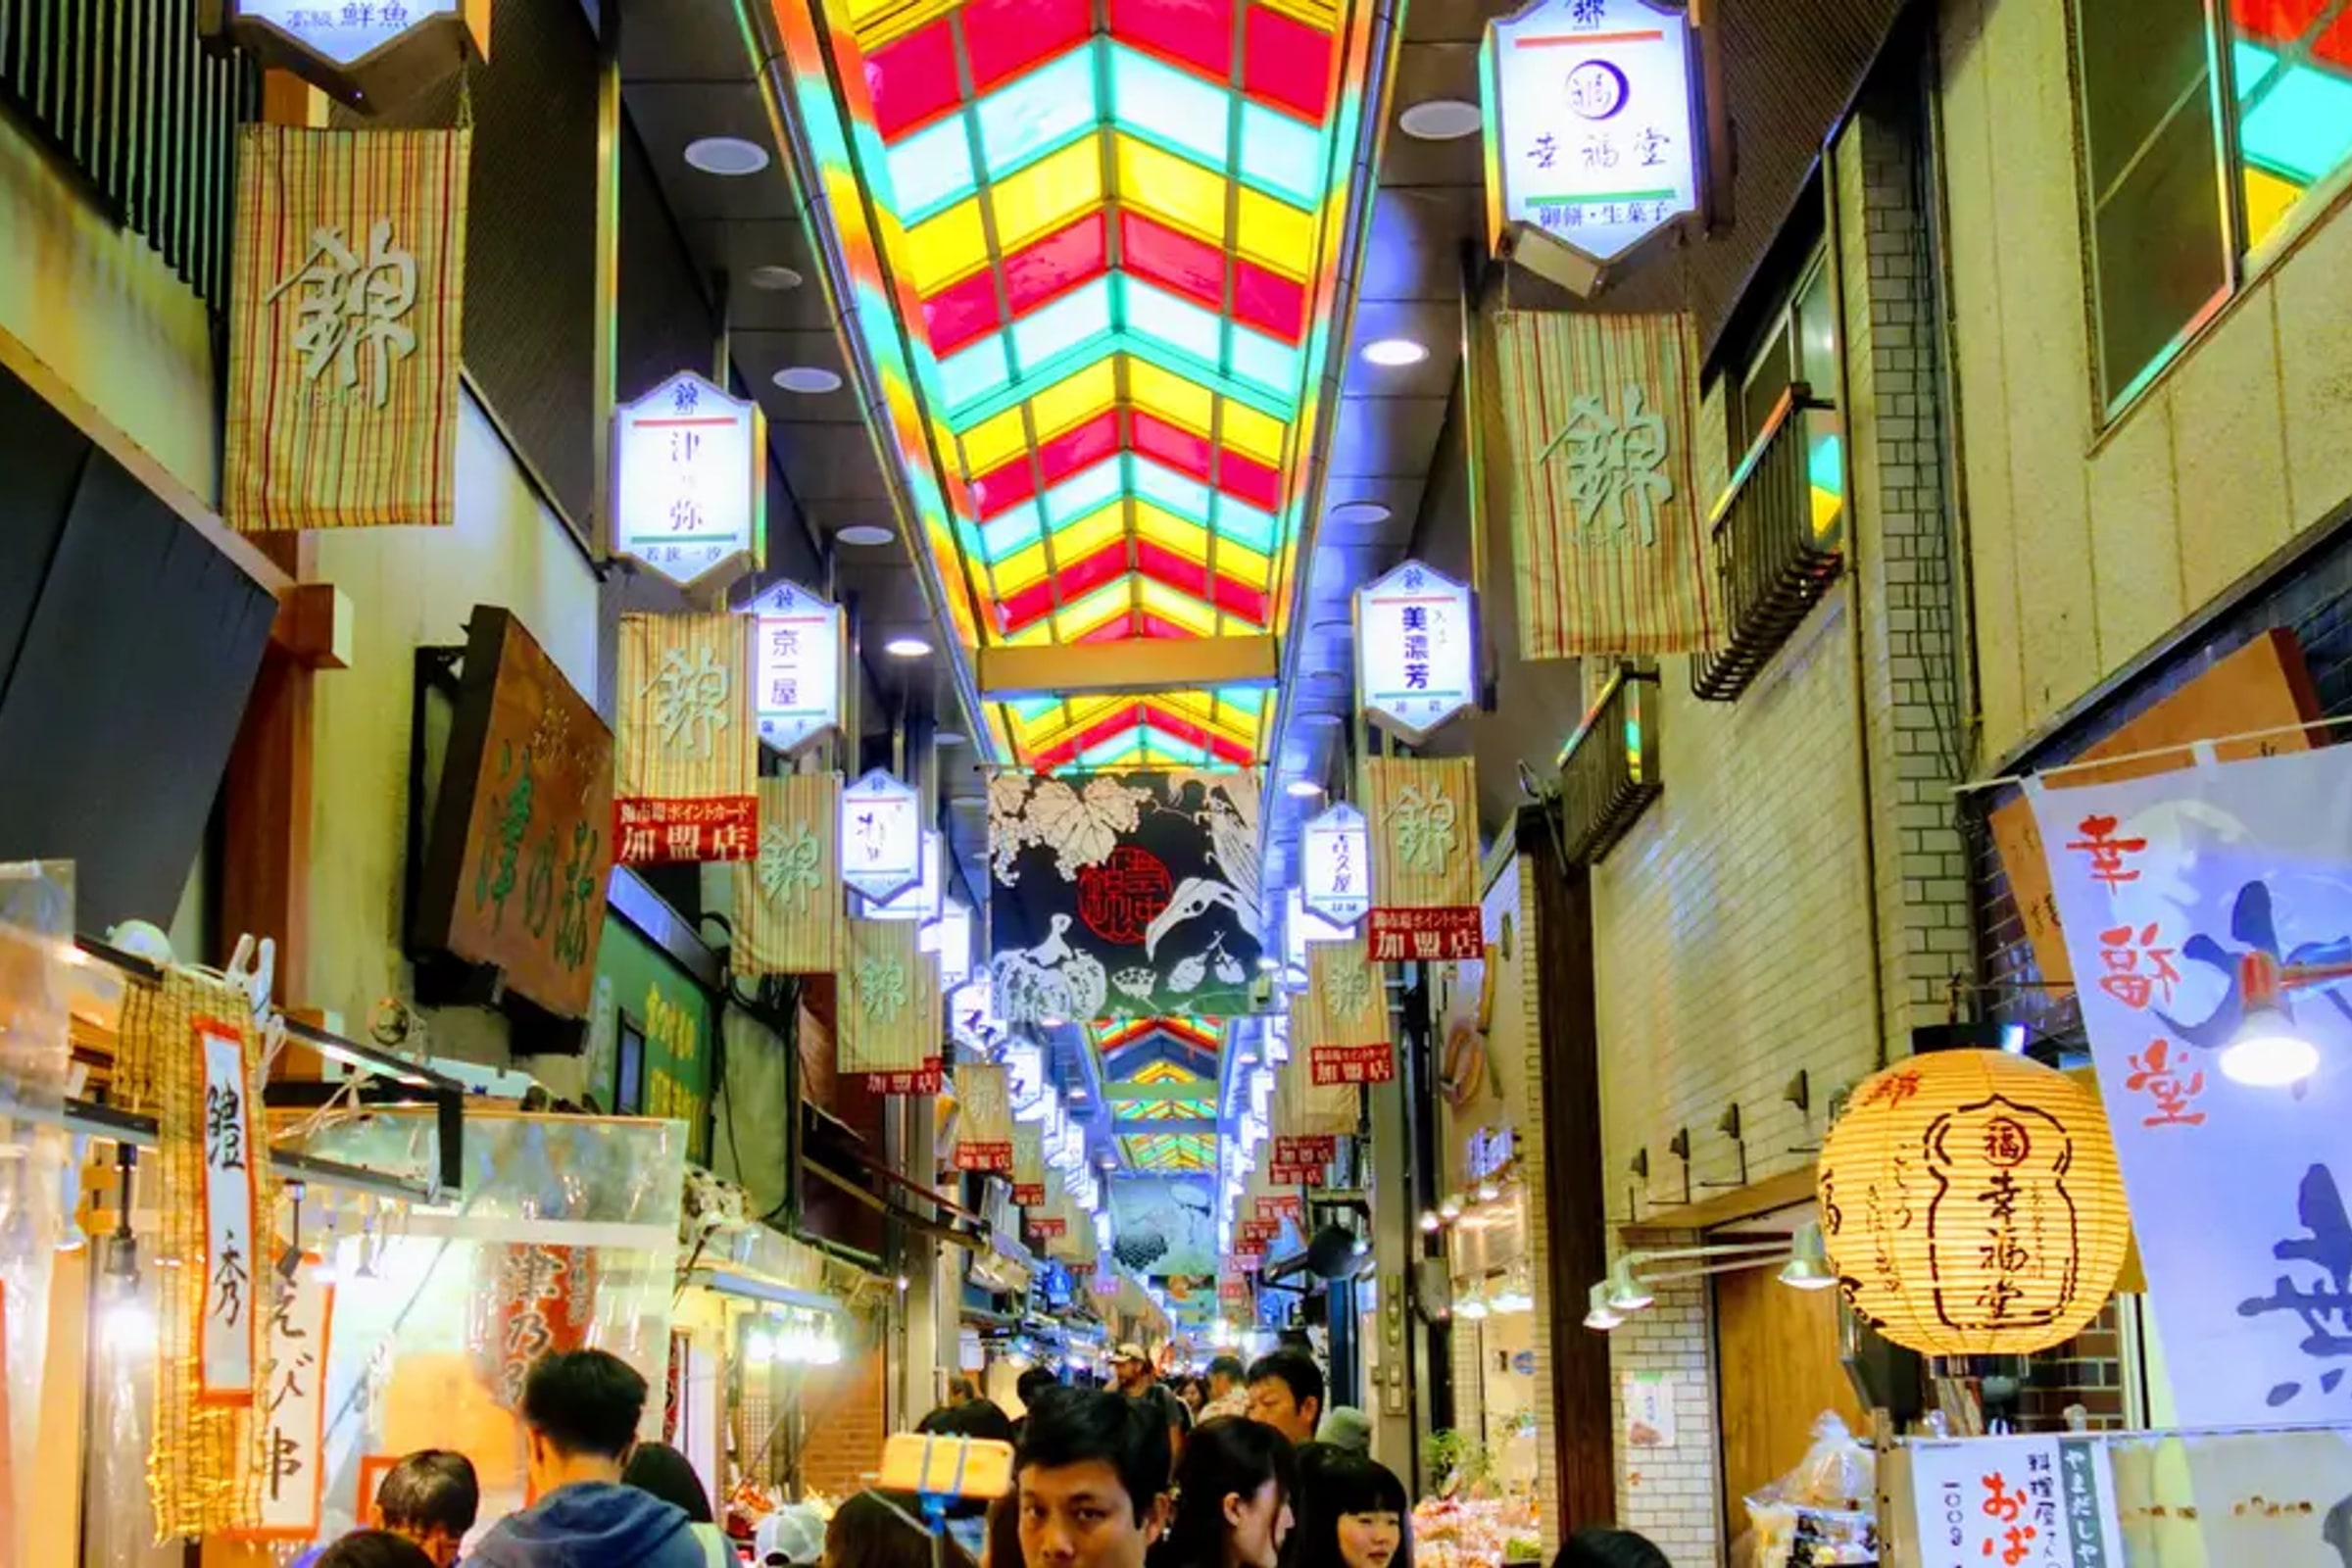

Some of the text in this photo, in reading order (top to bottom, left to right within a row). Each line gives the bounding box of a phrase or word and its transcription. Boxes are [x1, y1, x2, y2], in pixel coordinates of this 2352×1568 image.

[1526, 126, 1671, 171] 幸福堂
[264, 217, 417, 410] 錦
[1540, 383, 1674, 547] 錦
[640, 647, 731, 760] 錦
[621, 825, 750, 861] 加盟店
[1383, 782, 1459, 878] 錦
[1375, 930, 1481, 957] 加盟店
[1977, 1169, 2029, 1319] 幸福堂
[2027, 1452, 2063, 1568] 料理屋さん
